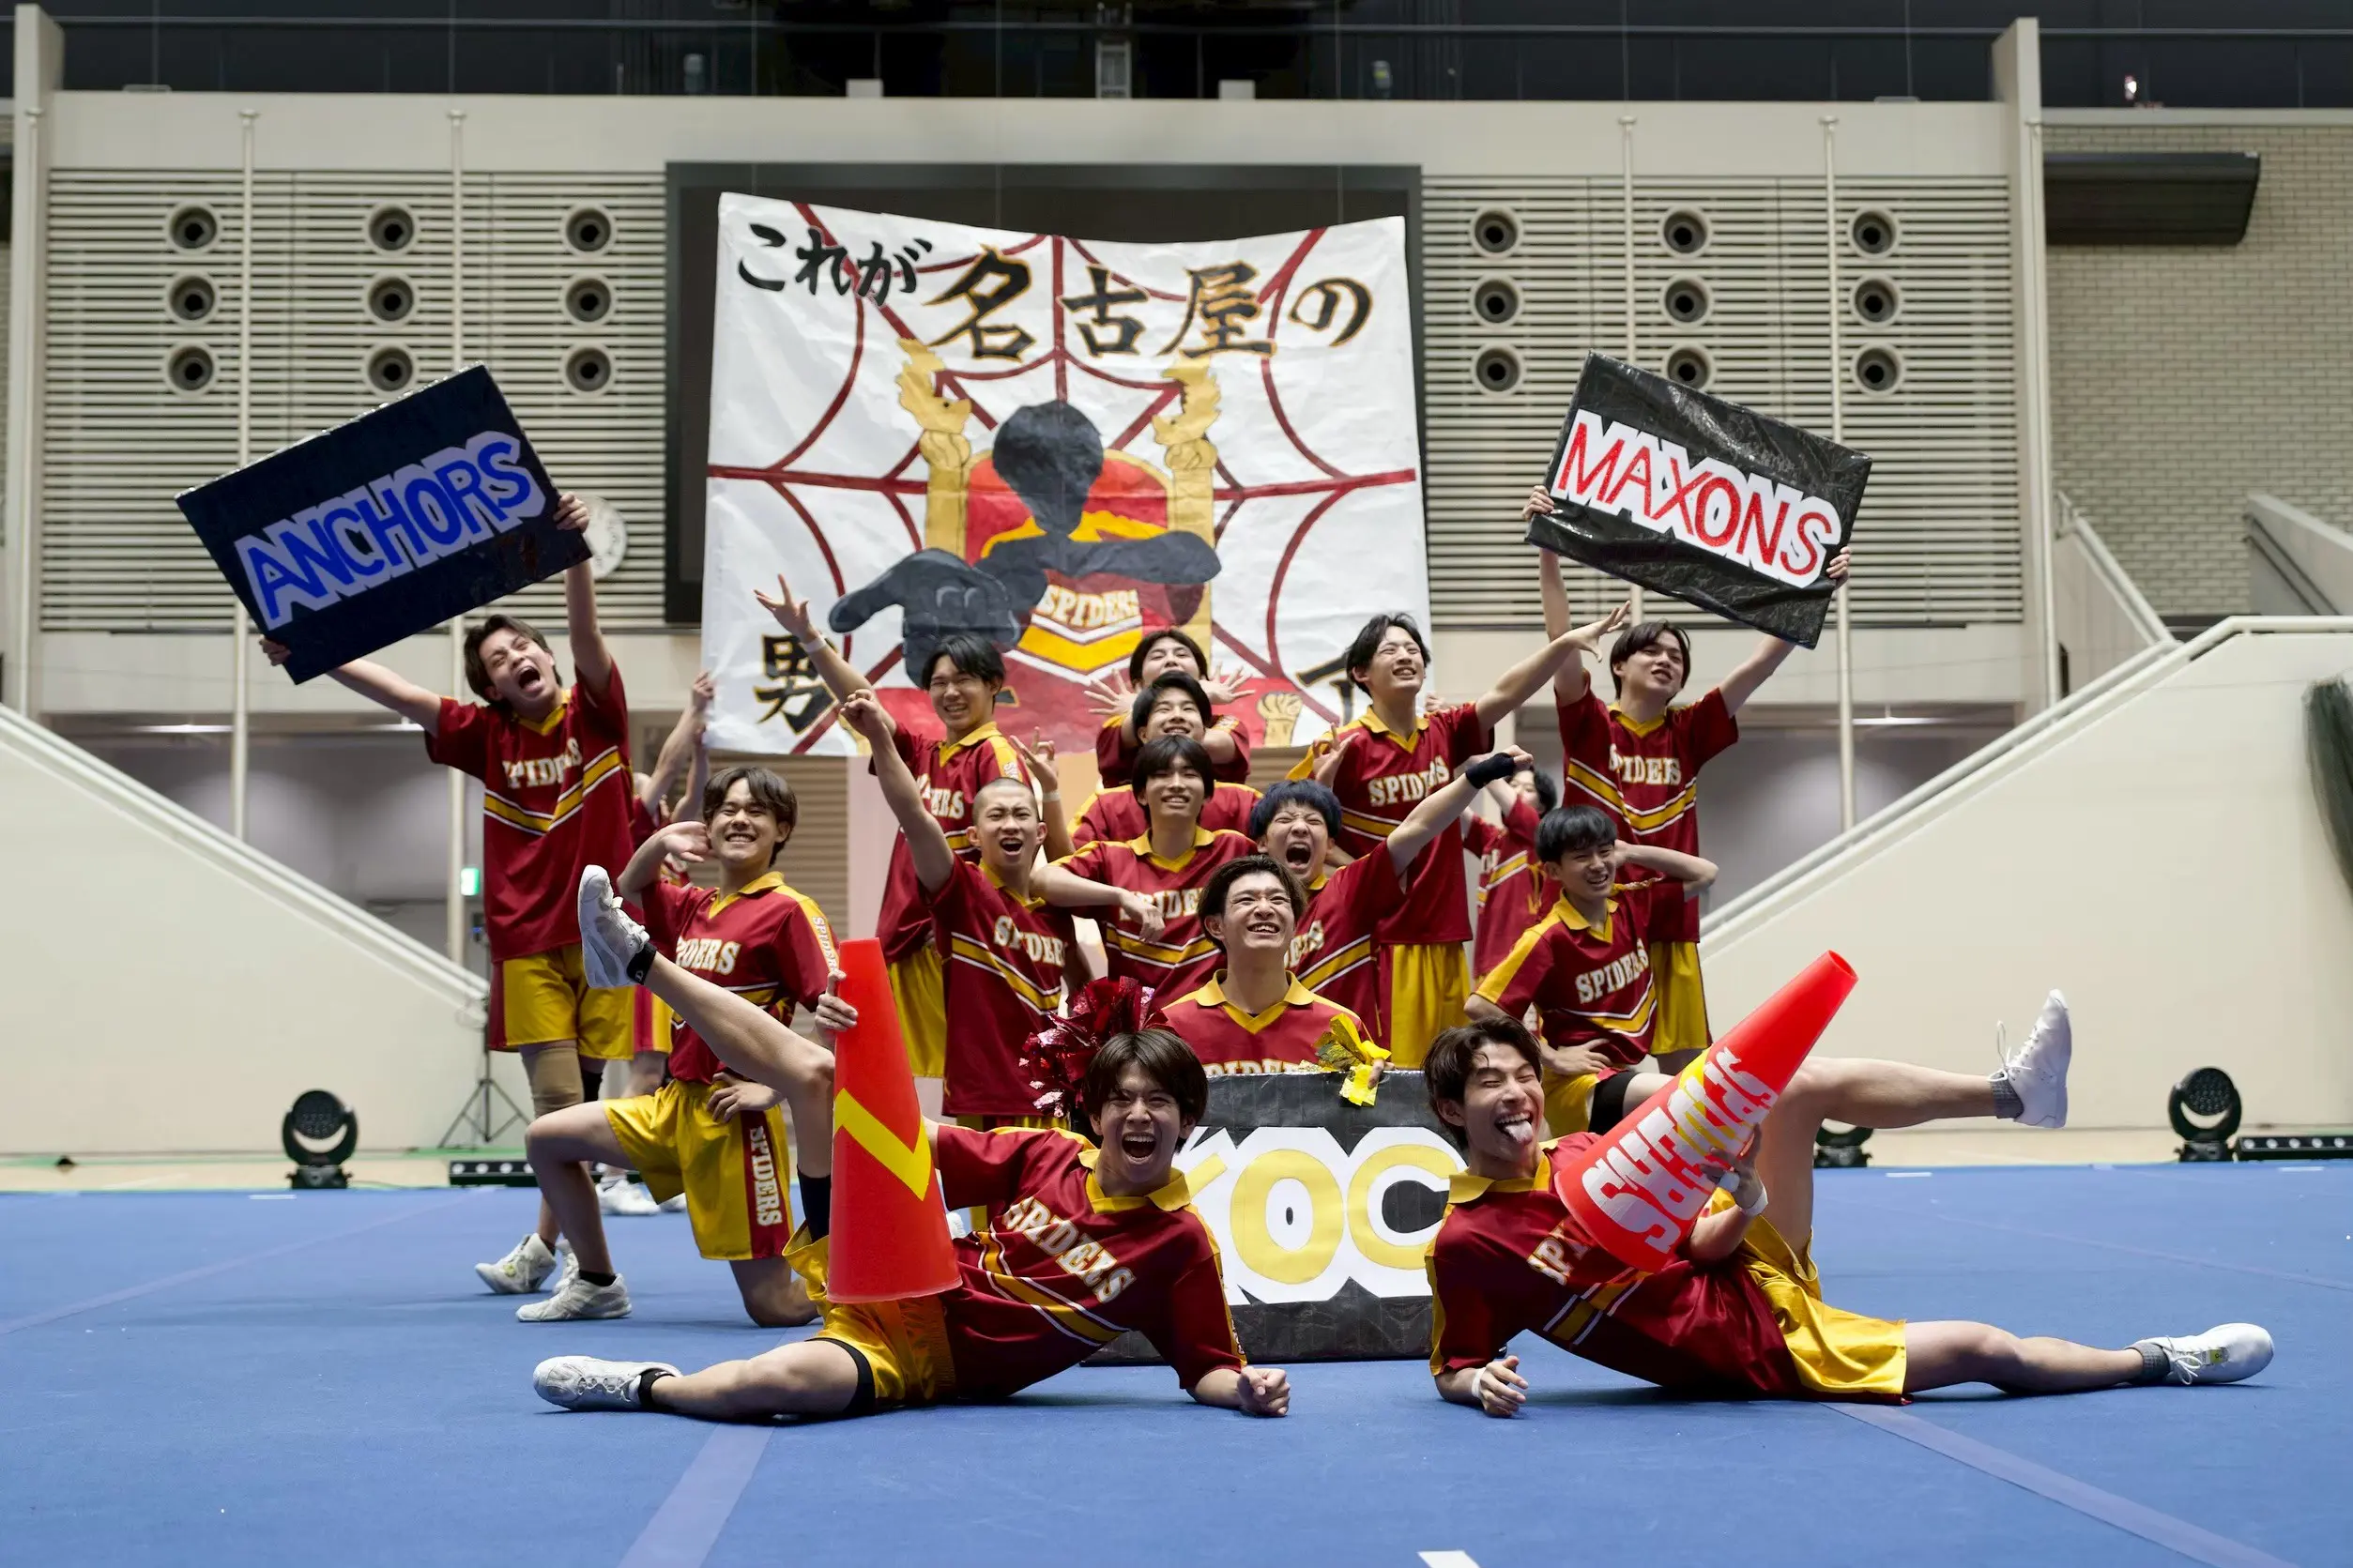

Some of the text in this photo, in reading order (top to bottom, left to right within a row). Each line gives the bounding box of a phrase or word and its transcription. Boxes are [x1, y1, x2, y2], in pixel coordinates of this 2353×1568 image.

[241, 434, 540, 627] ANCHORS
[1554, 417, 1836, 582] MAXONS
[749, 1125, 784, 1226] SPIDERS
[1184, 1143, 1459, 1286] OC
